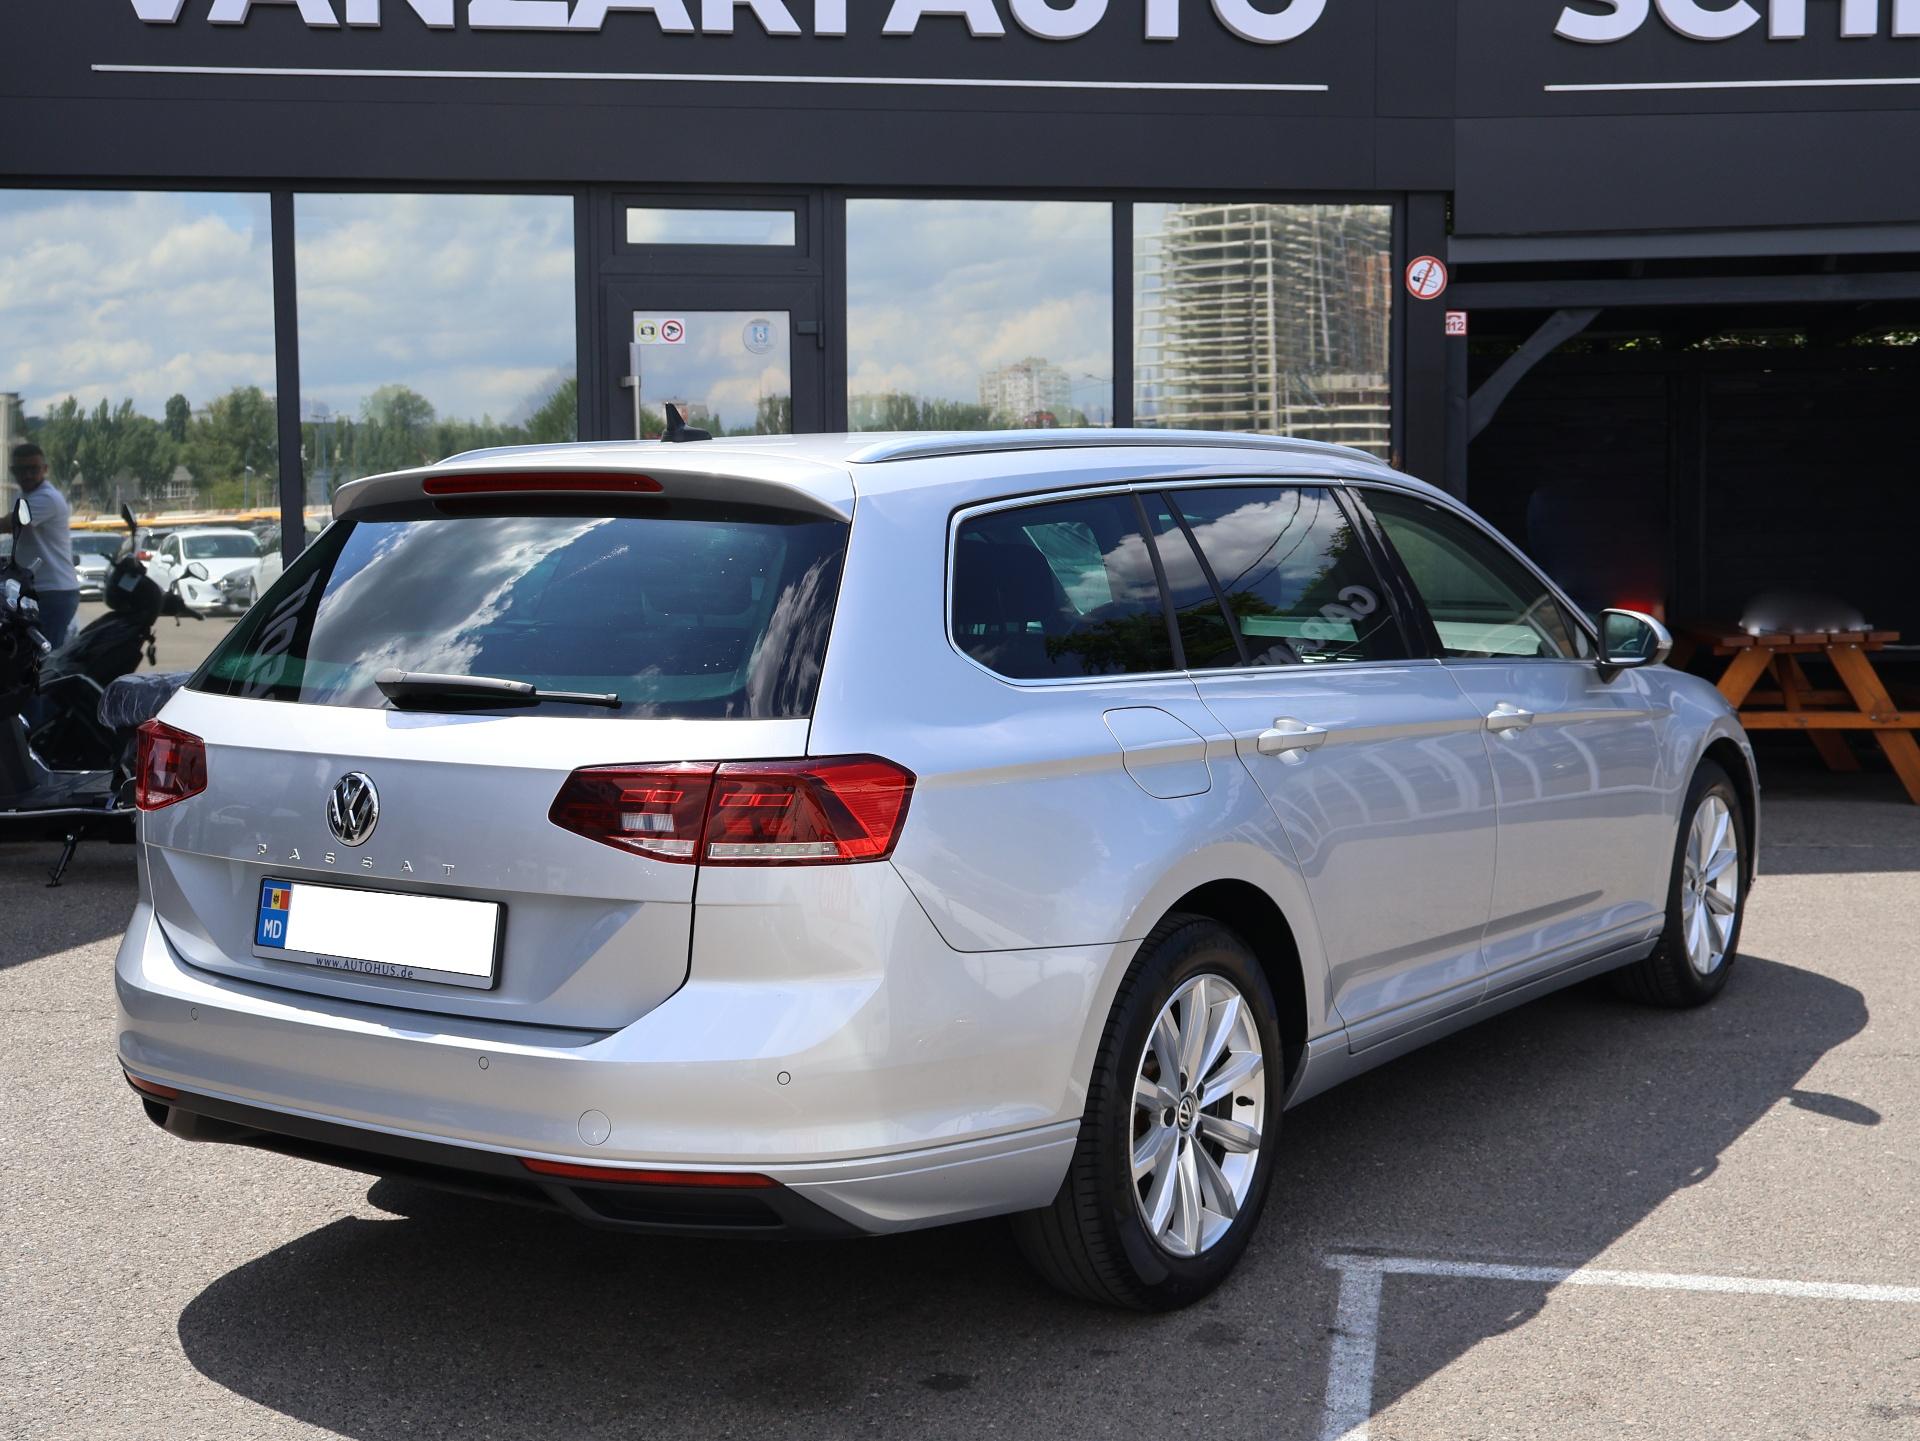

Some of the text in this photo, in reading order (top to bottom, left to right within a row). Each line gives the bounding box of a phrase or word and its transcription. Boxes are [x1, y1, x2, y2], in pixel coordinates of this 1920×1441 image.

[1446, 321, 1465, 332] 112
[256, 842, 456, 876] PASSAT
[263, 918, 283, 939] MD
[315, 956, 415, 980] www.AUTOHUS.de
